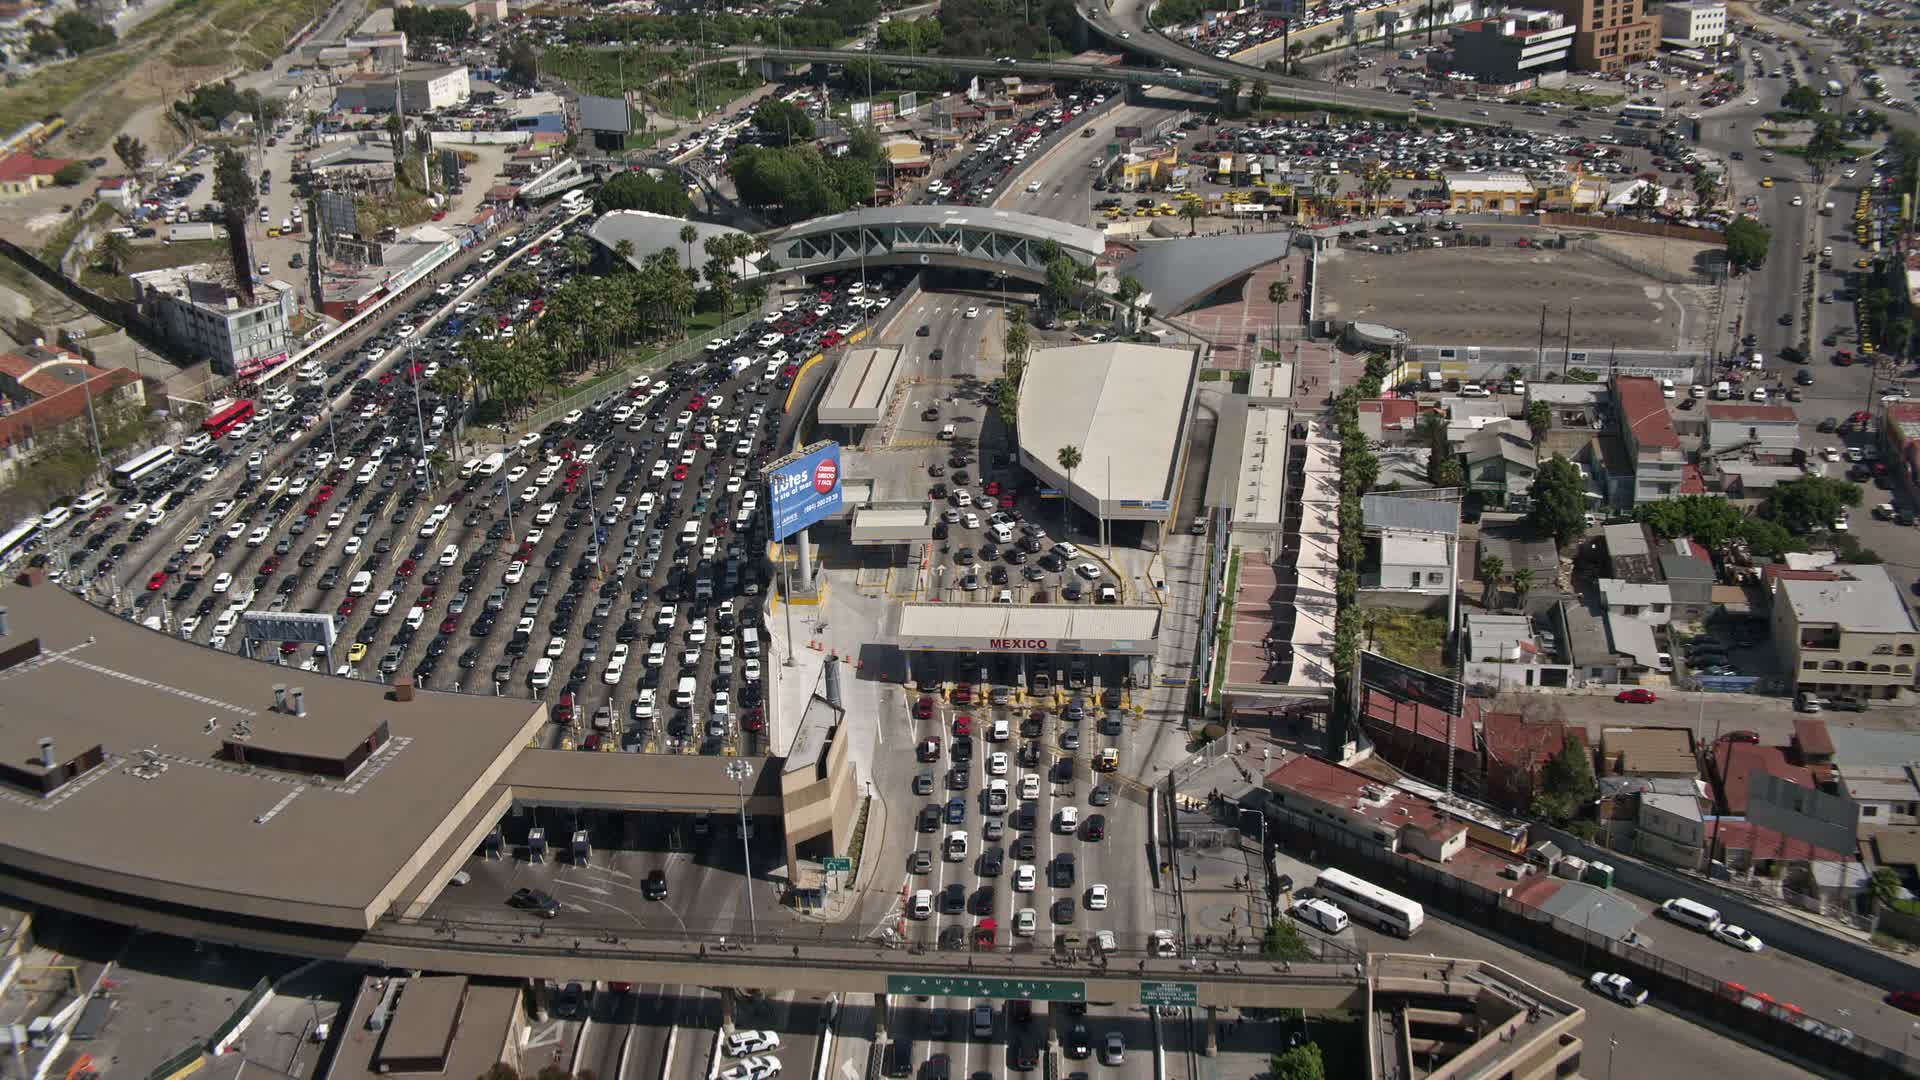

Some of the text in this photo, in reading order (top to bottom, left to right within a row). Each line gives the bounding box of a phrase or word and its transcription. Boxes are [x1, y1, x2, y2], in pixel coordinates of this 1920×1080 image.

[991, 639, 1048, 649] MEXICO
[921, 979, 1052, 990] AUTOS ONLY
